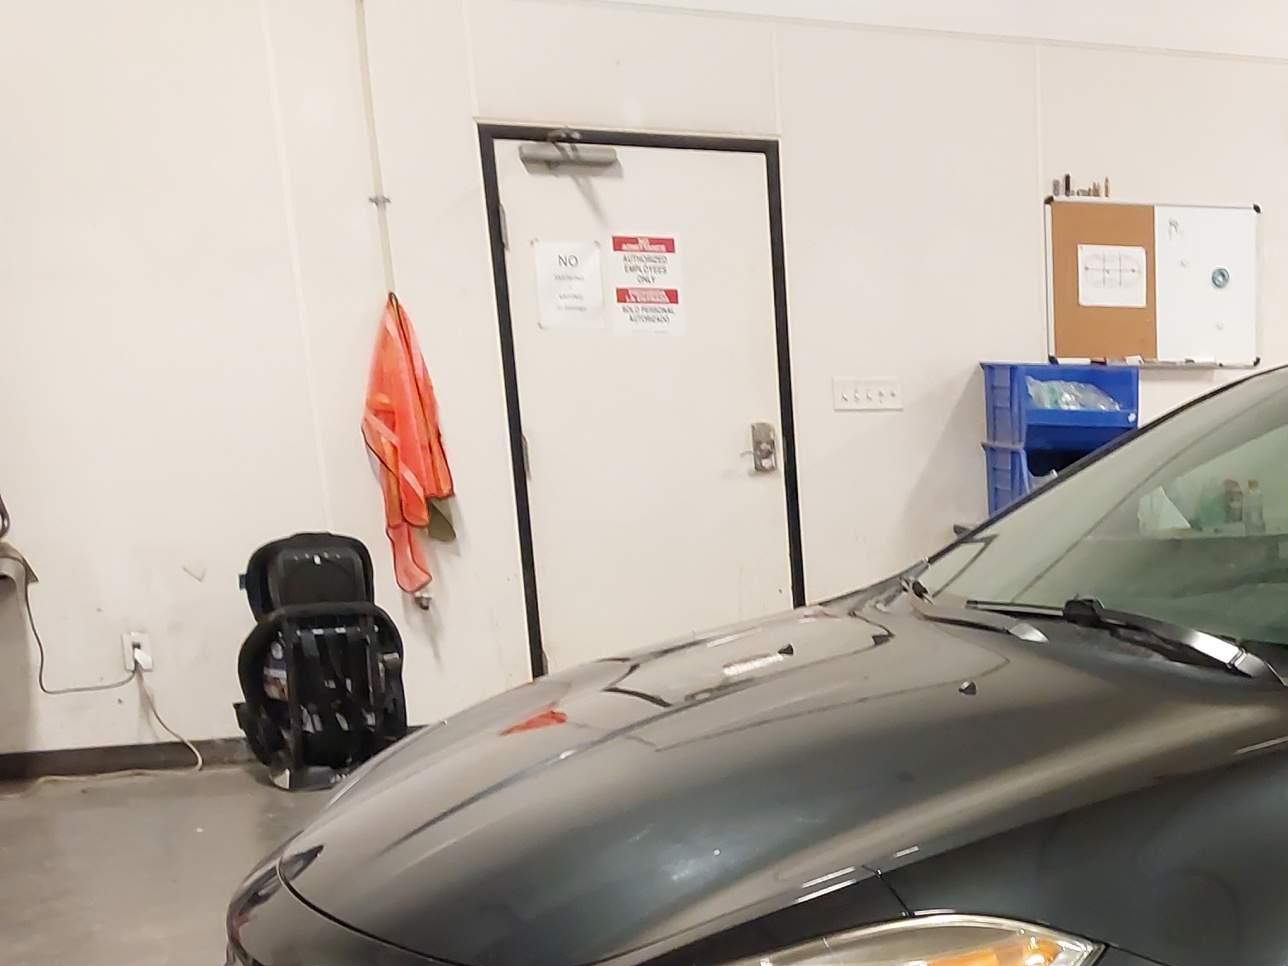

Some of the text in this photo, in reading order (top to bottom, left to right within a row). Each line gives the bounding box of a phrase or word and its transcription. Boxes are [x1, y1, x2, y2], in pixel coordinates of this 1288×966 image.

[558, 254, 578, 267] NO
[623, 254, 667, 264] AUTHORIZED
[624, 264, 667, 274] EMPLOYEES
[637, 275, 655, 284] ONLY
